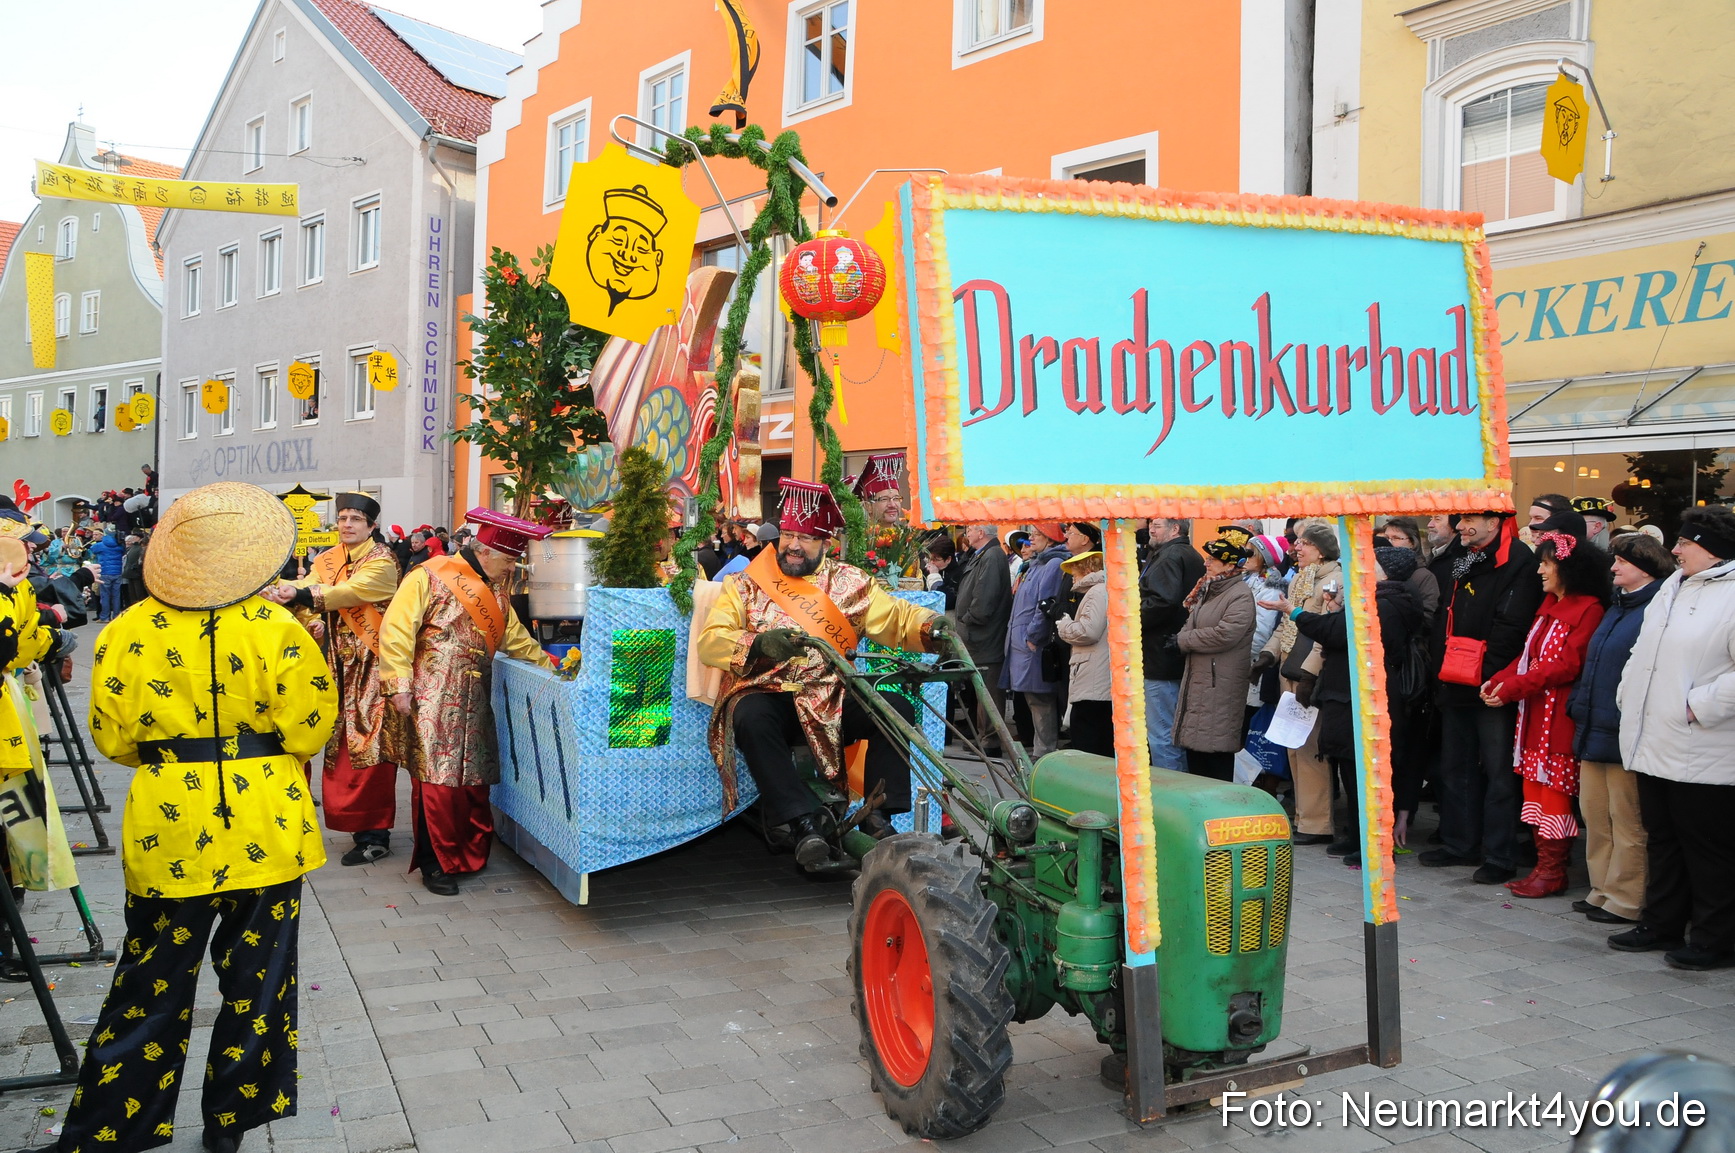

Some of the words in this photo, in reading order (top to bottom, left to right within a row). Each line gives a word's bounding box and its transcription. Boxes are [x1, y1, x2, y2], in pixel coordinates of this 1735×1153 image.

[428, 216, 442, 308] UHREN
[1495, 259, 1735, 346] CKERE
[423, 321, 438, 450] SCHMUCK
[952, 279, 1478, 459] Drachenkurbad
[214, 444, 262, 476] OPTIK
[266, 437, 318, 473] OEXL
[296, 547, 306, 555] 33
[1211, 819, 1288, 840] Holder
